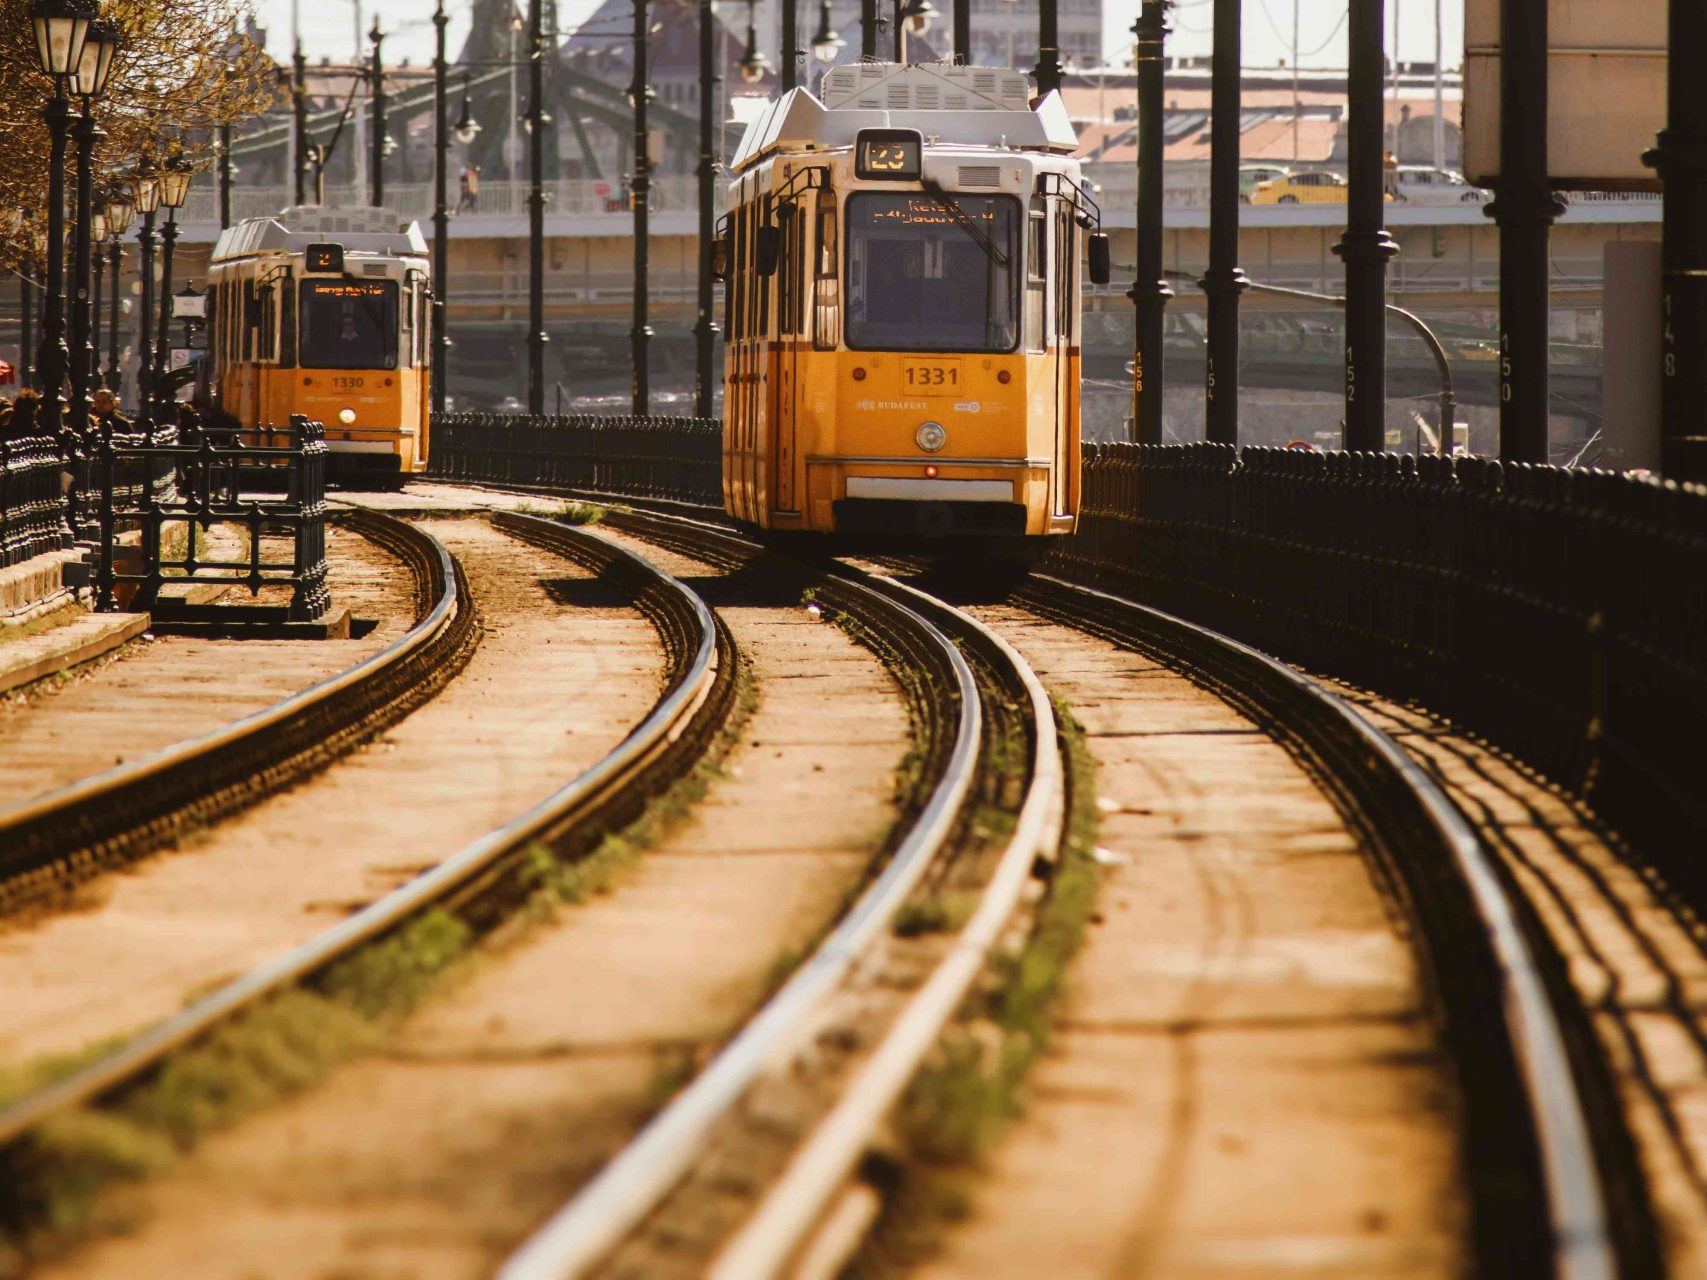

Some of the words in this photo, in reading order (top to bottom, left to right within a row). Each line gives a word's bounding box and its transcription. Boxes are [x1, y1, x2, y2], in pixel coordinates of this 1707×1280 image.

[905, 367, 958, 385] 1331
[1346, 346, 1355, 401] 152
[1502, 333, 1511, 402] 150
[332, 377, 364, 388] 1330
[877, 401, 928, 410] BUDAPEST
